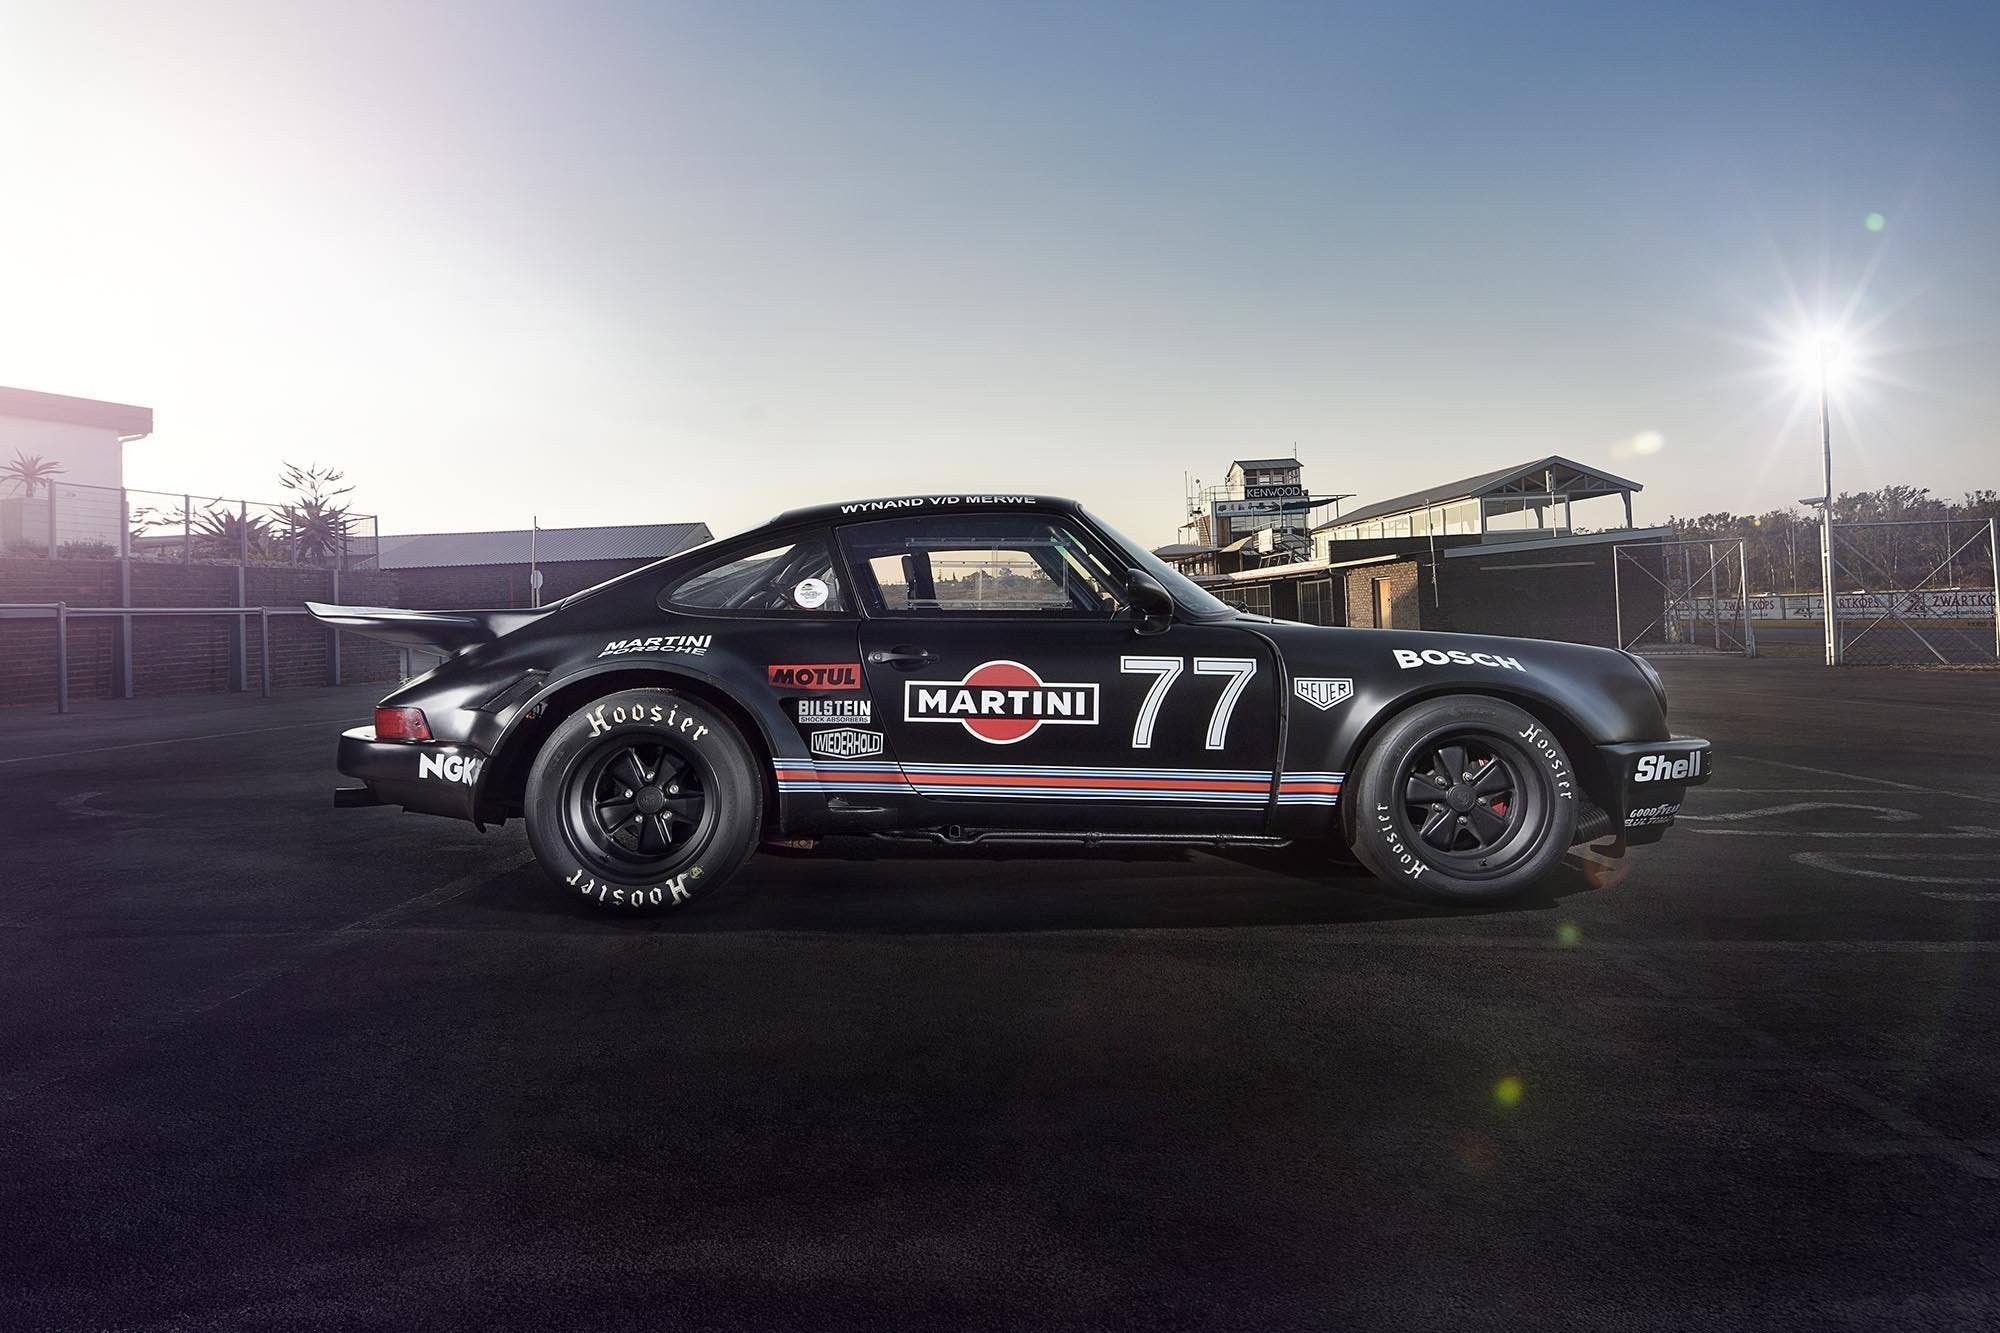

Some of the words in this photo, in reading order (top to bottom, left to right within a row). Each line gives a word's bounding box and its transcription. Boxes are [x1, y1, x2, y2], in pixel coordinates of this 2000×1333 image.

[1246, 486, 1300, 498] KENWOOD
[841, 498, 924, 514] WYNAND
[929, 496, 960, 505] V/D
[966, 496, 1037, 504] MERWE
[1723, 600, 1775, 611] ZWAKOPS
[1816, 597, 1880, 608] ZRTKOPS
[1933, 594, 1997, 607] ZWARTKO
[598, 645, 707, 658] PORSCHE
[604, 635, 712, 651] MARTINI
[1392, 649, 1527, 673] BOSCH
[773, 668, 857, 685] MOTUL
[917, 689, 1086, 716] MARTINI
[1120, 655, 1257, 750] 77
[1300, 682, 1347, 704] HEUER
[798, 700, 871, 716] BILSTEIN
[585, 703, 709, 741] Hoosier
[814, 731, 880, 755] WIEDERHOLD
[419, 752, 476, 787] NGK
[1519, 723, 1572, 800] Hoosier
[1634, 750, 1701, 782] Shell
[1377, 802, 1430, 879] Hoosier
[566, 869, 693, 907] Hoosier
